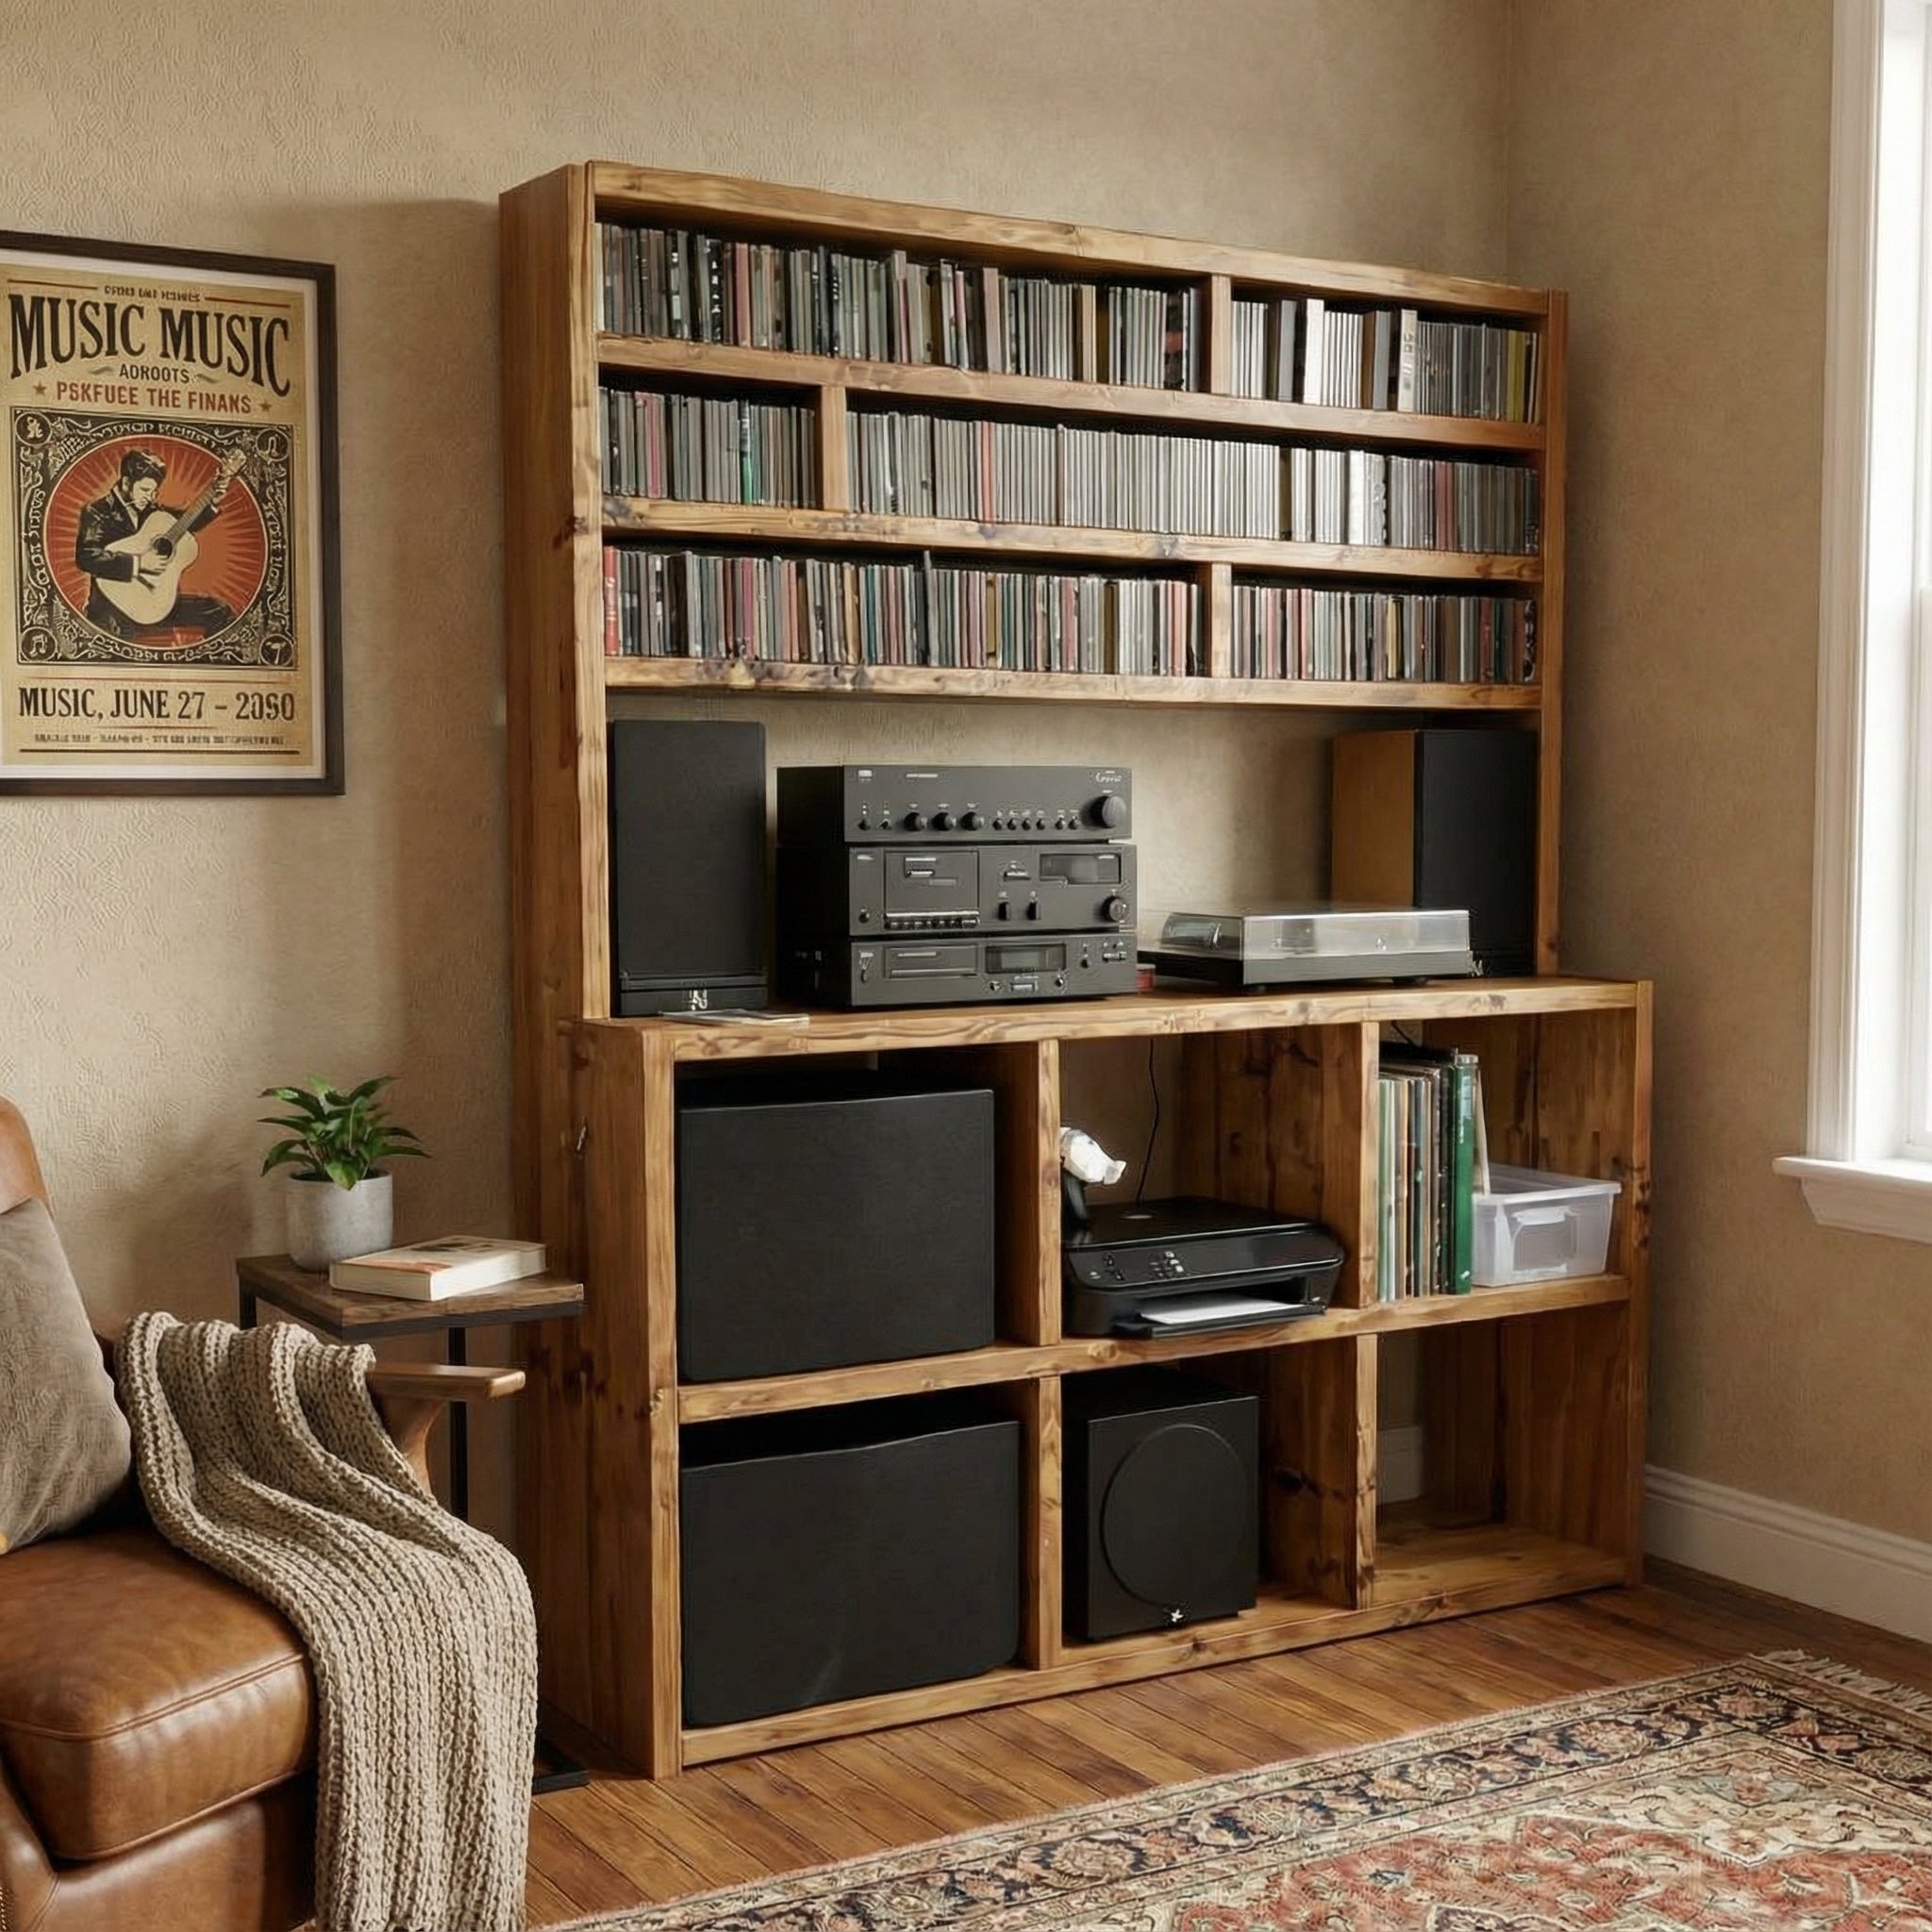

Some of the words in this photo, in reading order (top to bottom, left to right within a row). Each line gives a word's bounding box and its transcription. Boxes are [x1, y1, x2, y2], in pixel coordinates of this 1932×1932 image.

[8, 294, 145, 379] MUSIC
[158, 308, 291, 397] MUSIC
[146, 388, 181, 408] THE
[18, 687, 104, 721] MUSIC,
[109, 689, 171, 718] JUNE
[177, 691, 206, 720] 27
